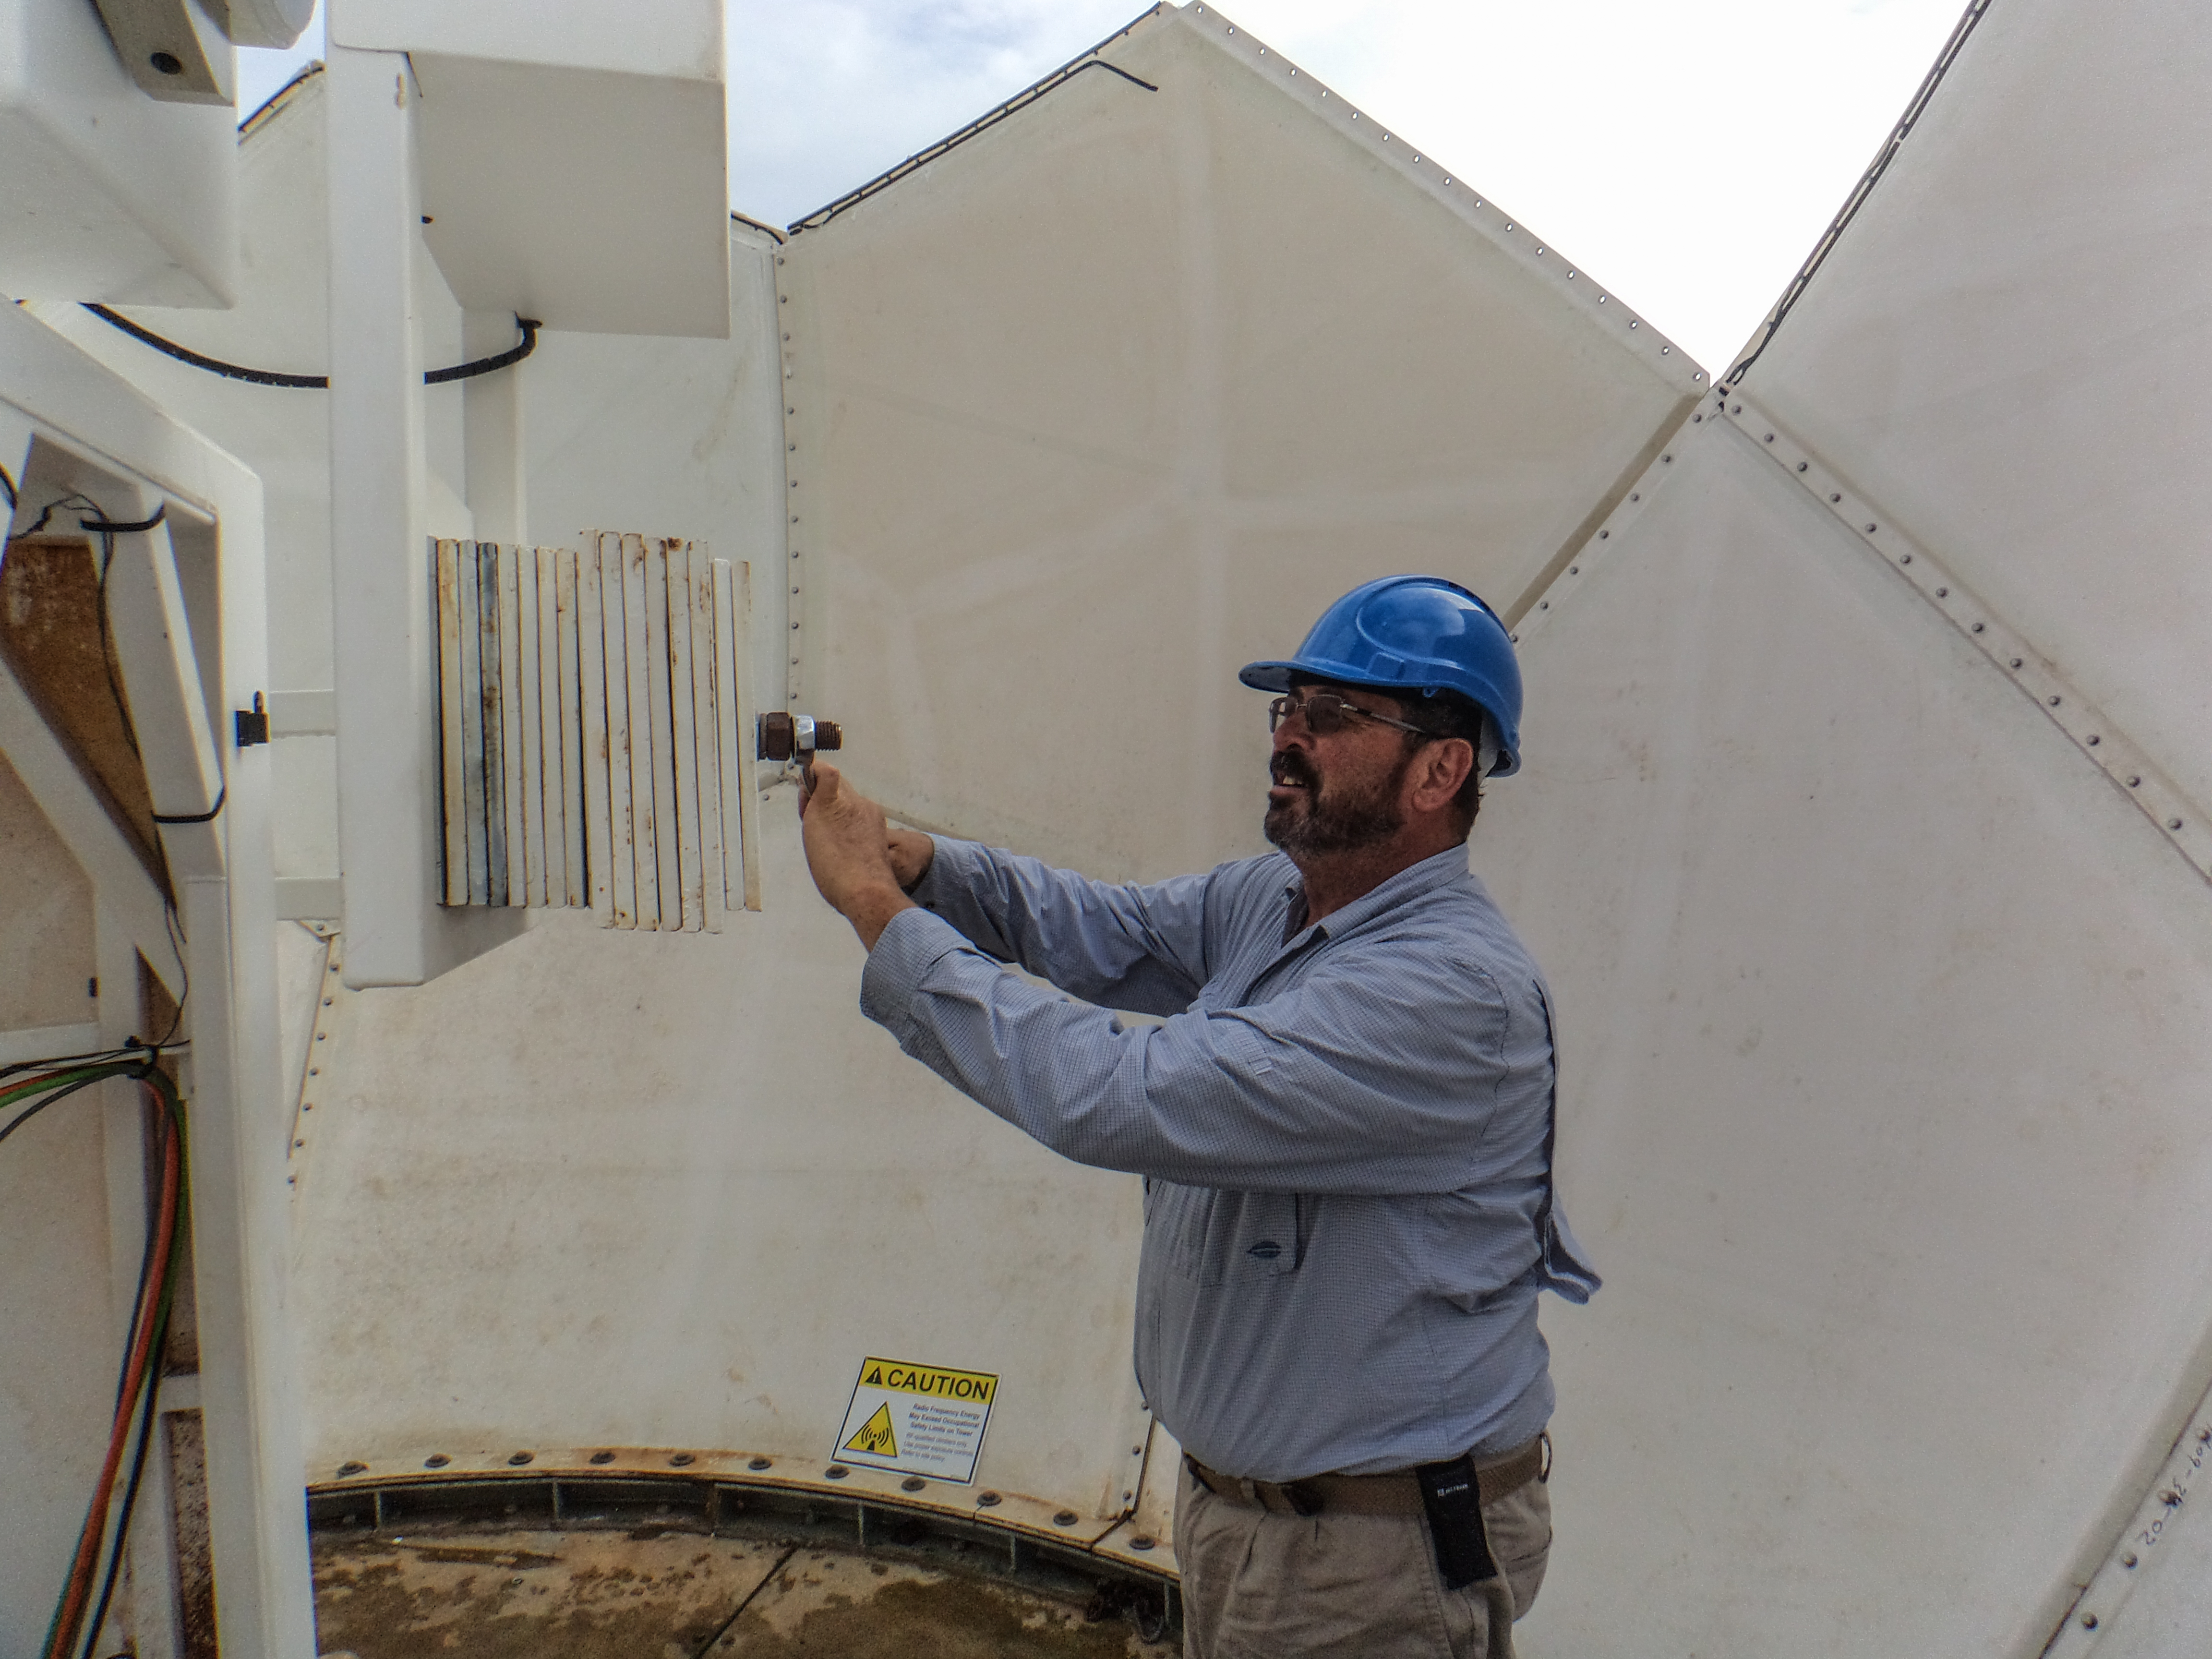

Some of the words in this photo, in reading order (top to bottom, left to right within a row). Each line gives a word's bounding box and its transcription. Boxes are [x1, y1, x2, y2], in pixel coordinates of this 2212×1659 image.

[888, 1369, 989, 1399] CAUTION
[909, 1412, 921, 1420] May
[921, 1414, 942, 1423] Exceed
[943, 1417, 980, 1428] Occupational
[930, 1406, 959, 1417] Frequency
[961, 1410, 980, 1419] Energy
[911, 1421, 928, 1431] Safety
[929, 1424, 945, 1432] Limits
[956, 1428, 973, 1436] Tower
